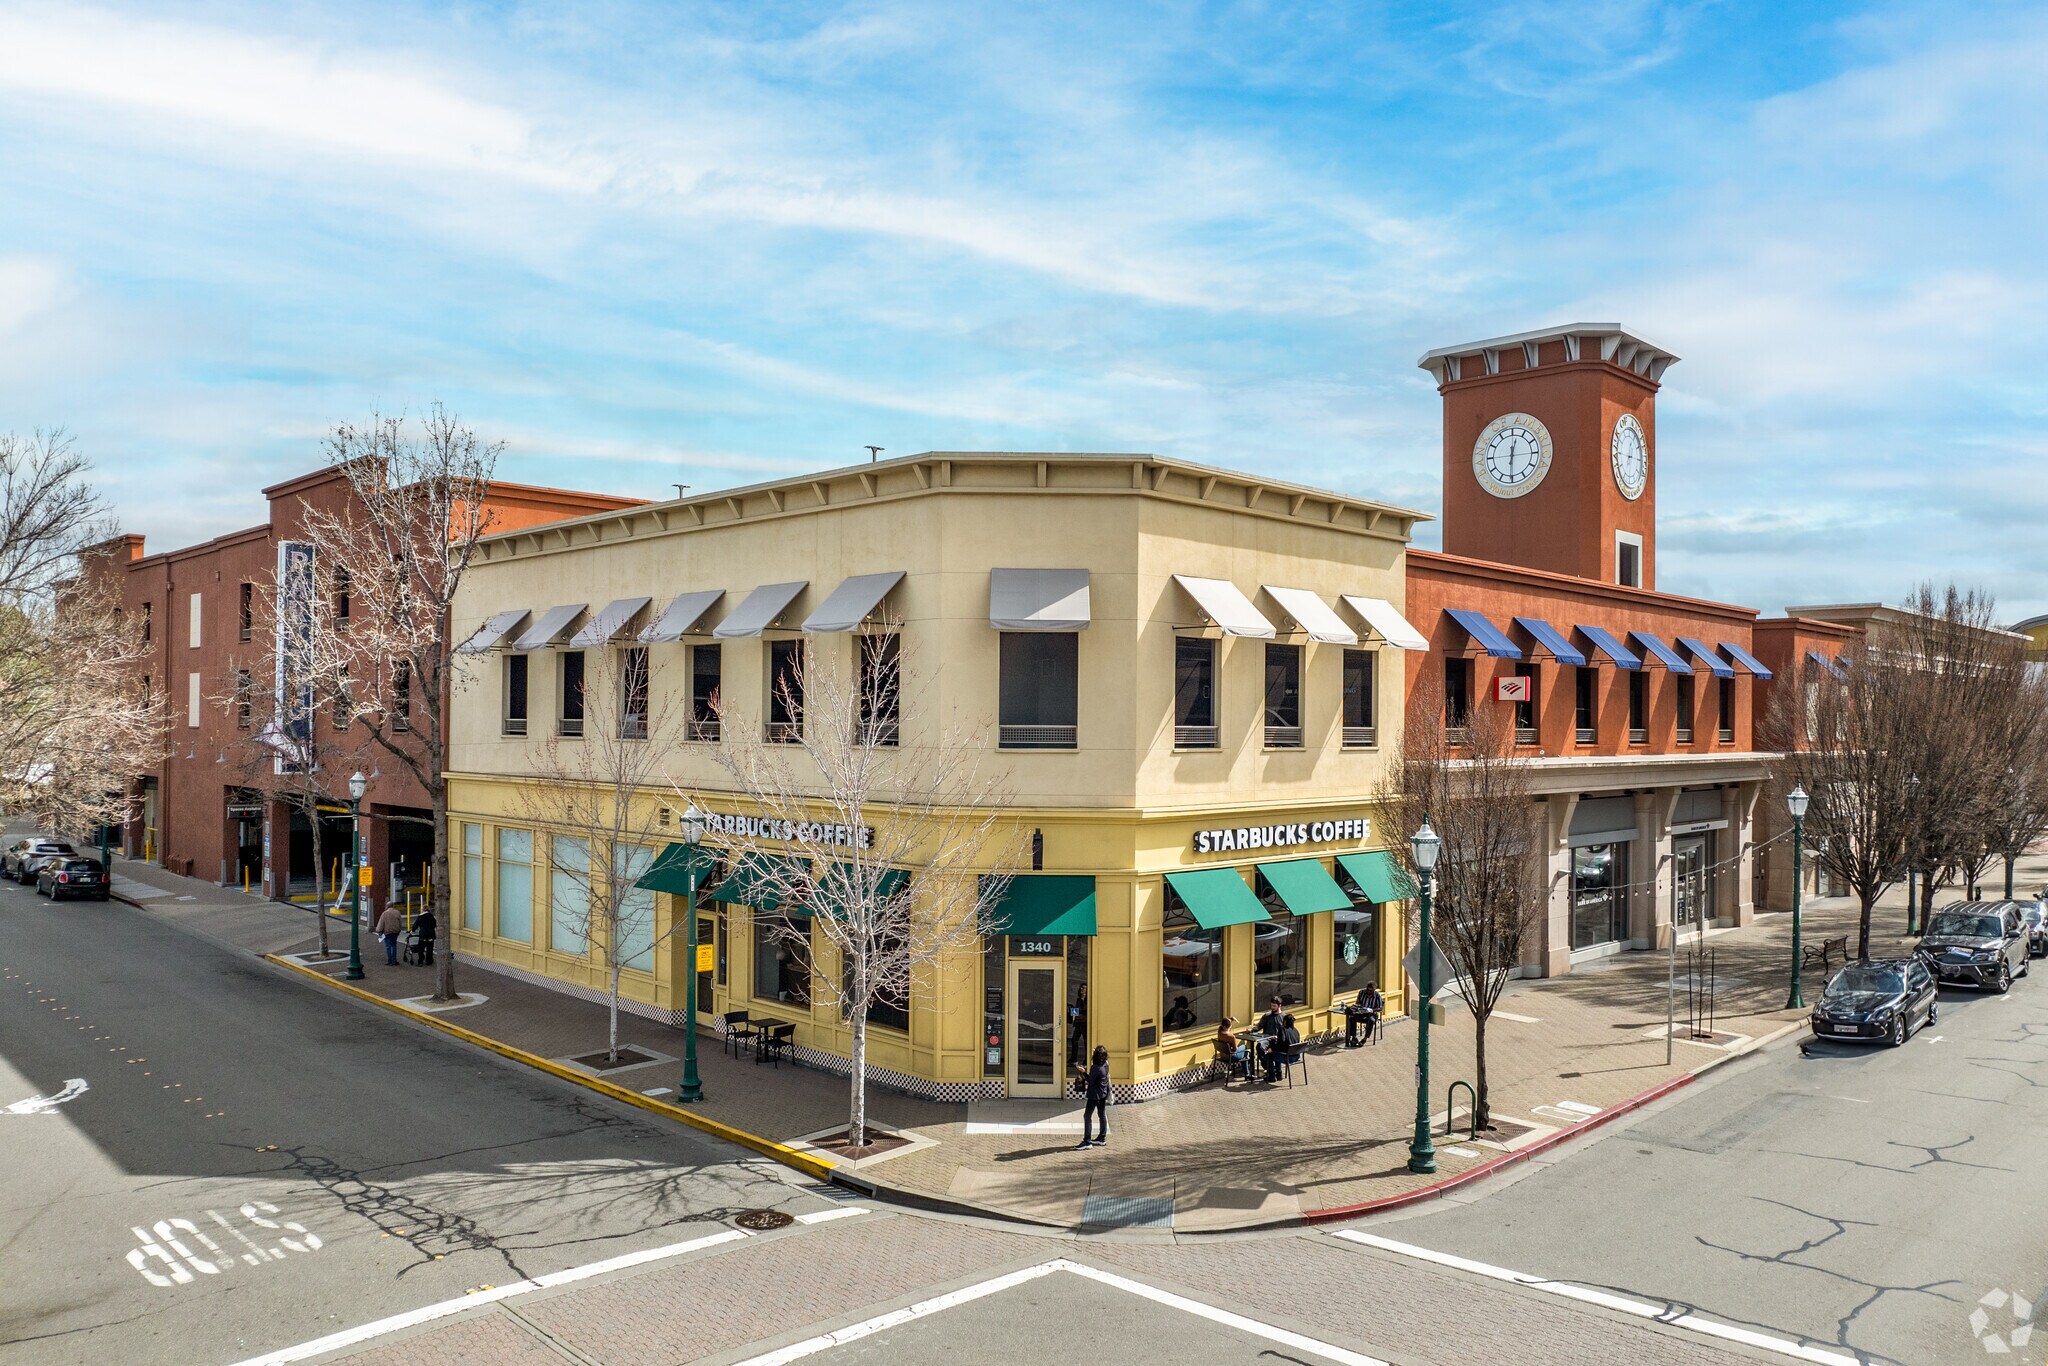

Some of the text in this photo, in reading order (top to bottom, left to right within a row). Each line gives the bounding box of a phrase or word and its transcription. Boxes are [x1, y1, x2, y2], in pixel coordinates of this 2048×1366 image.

[1474, 415, 1551, 478] BANK OF AMERICA
[704, 813, 794, 841] TARBUCKS
[1198, 818, 1371, 854] STARBUCKS COFFEE
[1020, 942, 1051, 952] 1340
[126, 1201, 323, 1287] STOP
